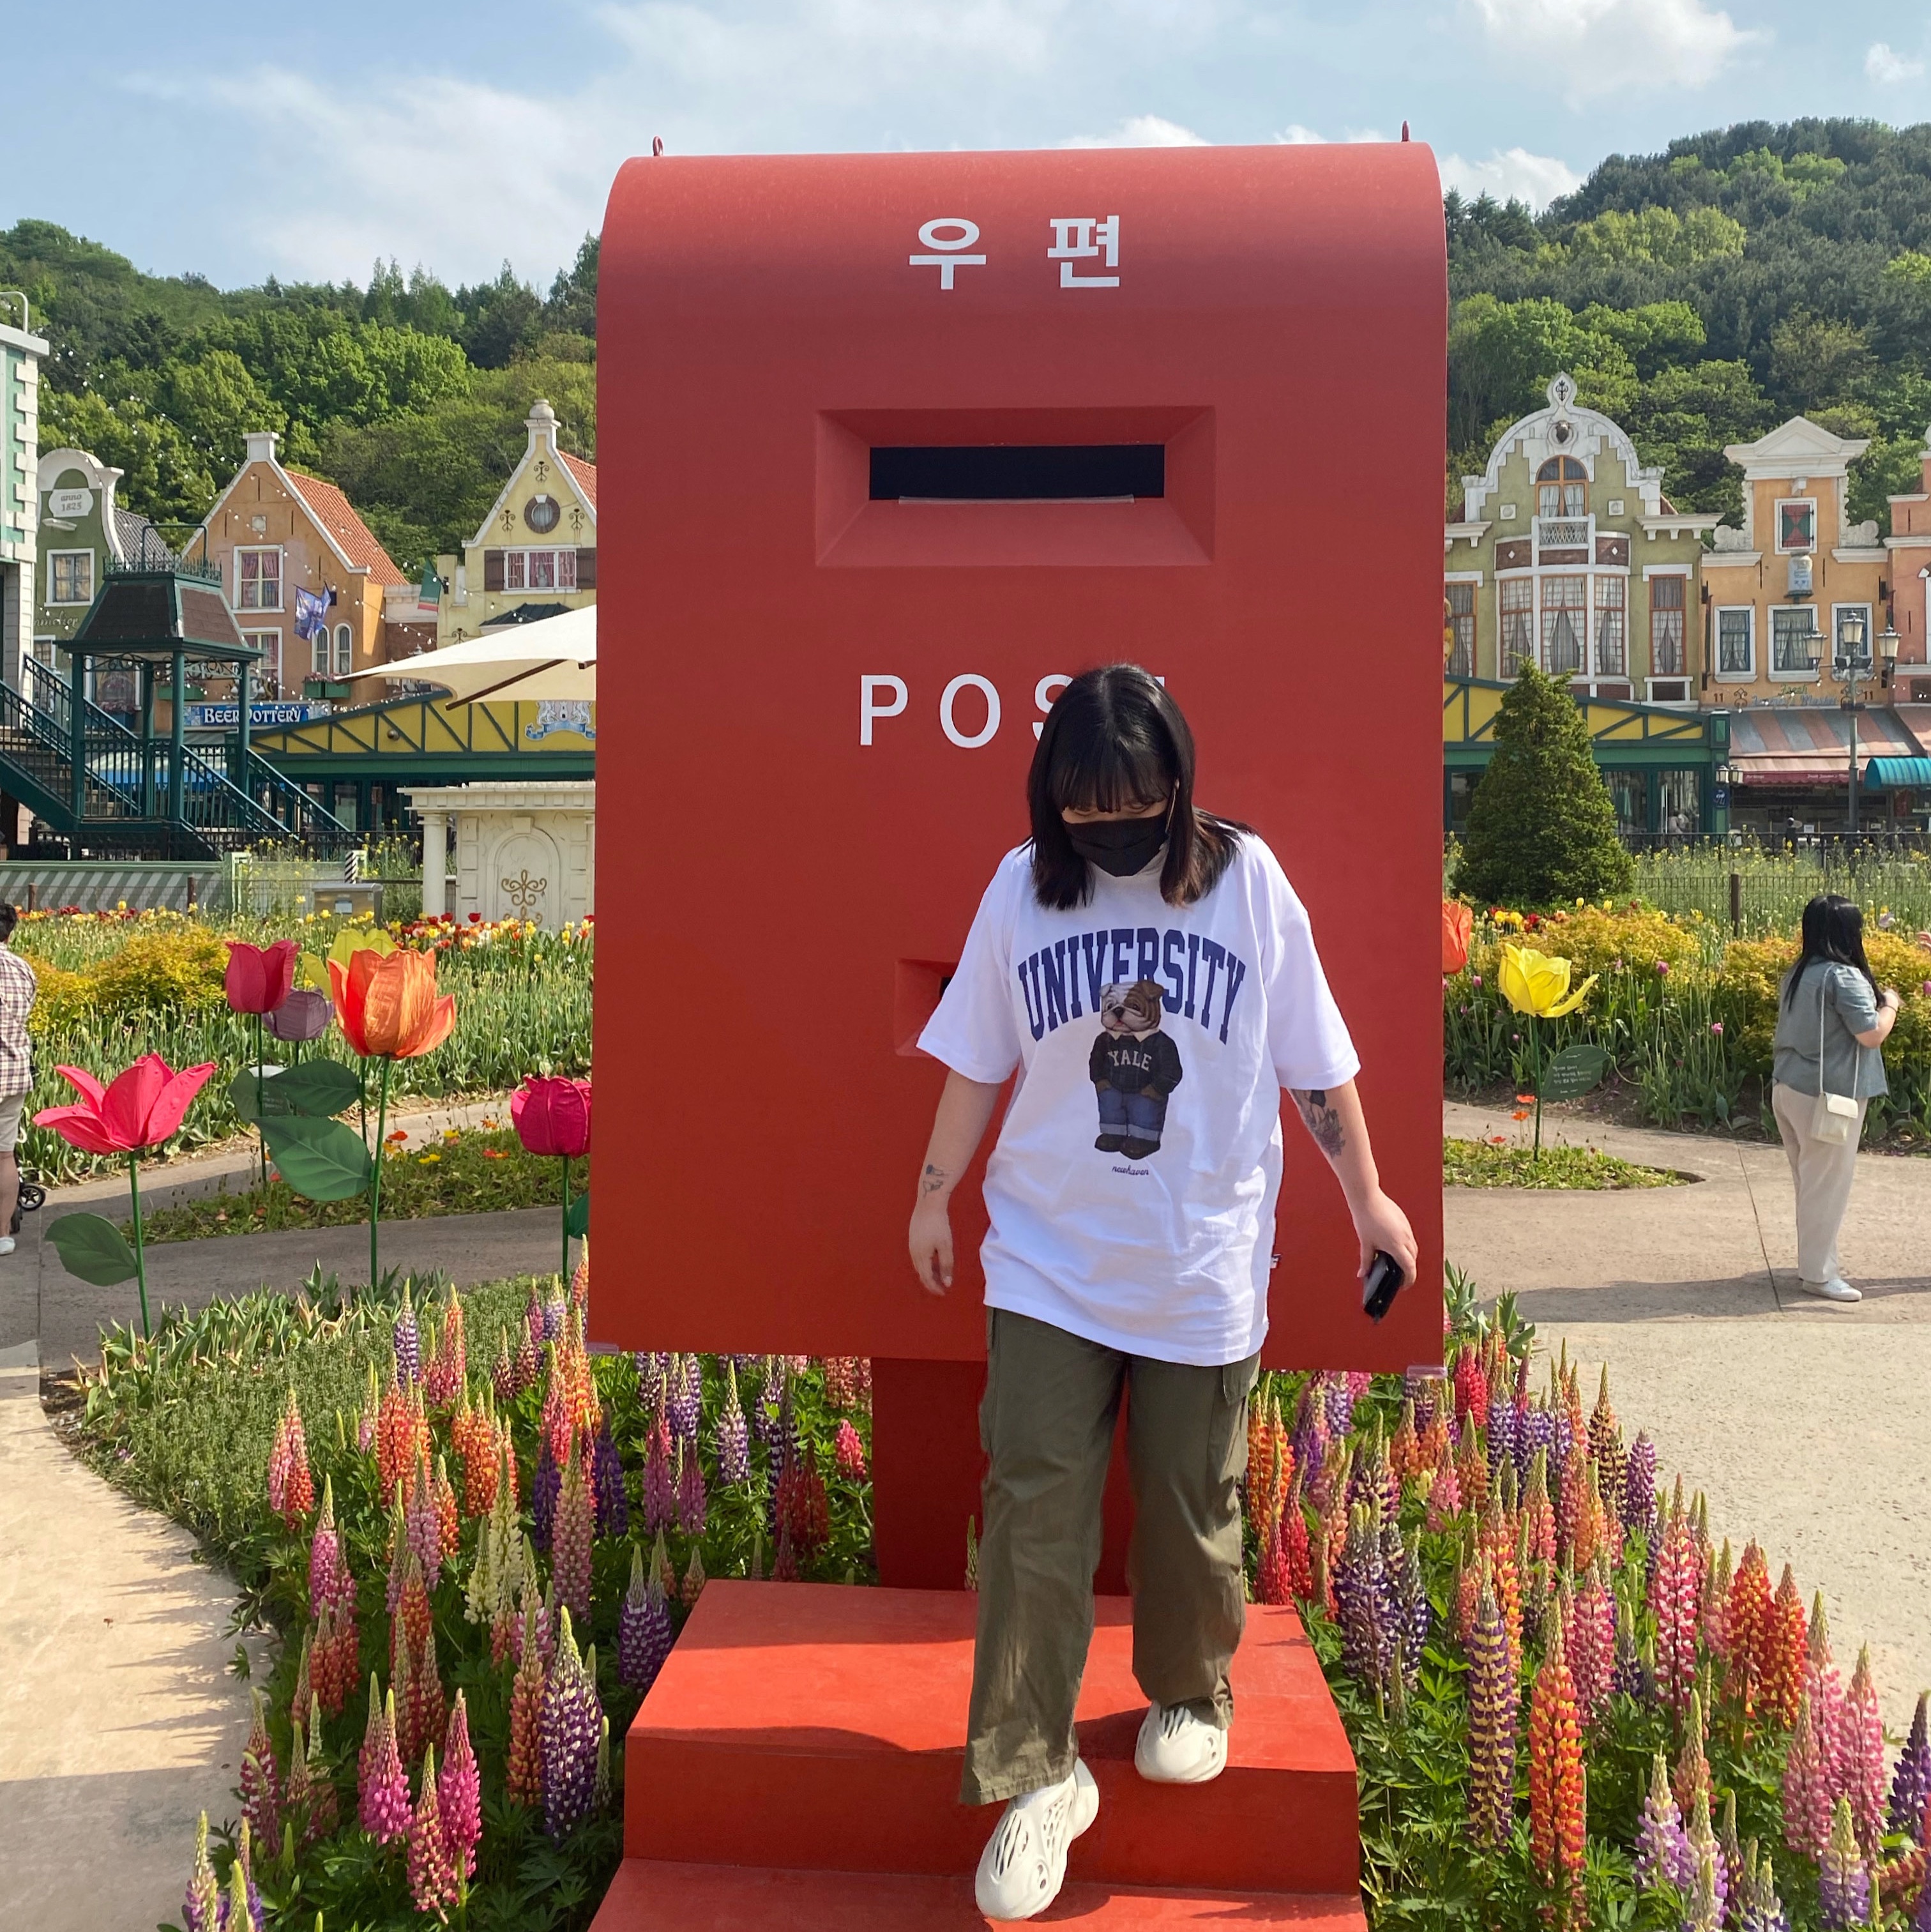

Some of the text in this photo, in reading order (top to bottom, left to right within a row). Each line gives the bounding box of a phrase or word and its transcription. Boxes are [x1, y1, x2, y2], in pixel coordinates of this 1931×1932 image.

[61, 502, 82, 512] 1825
[1714, 693, 1723, 703] 11
[1864, 690, 1874, 701] 11
[1018, 927, 1246, 1046] UNIVERSITY
[1107, 1049, 1152, 1072] YALE
